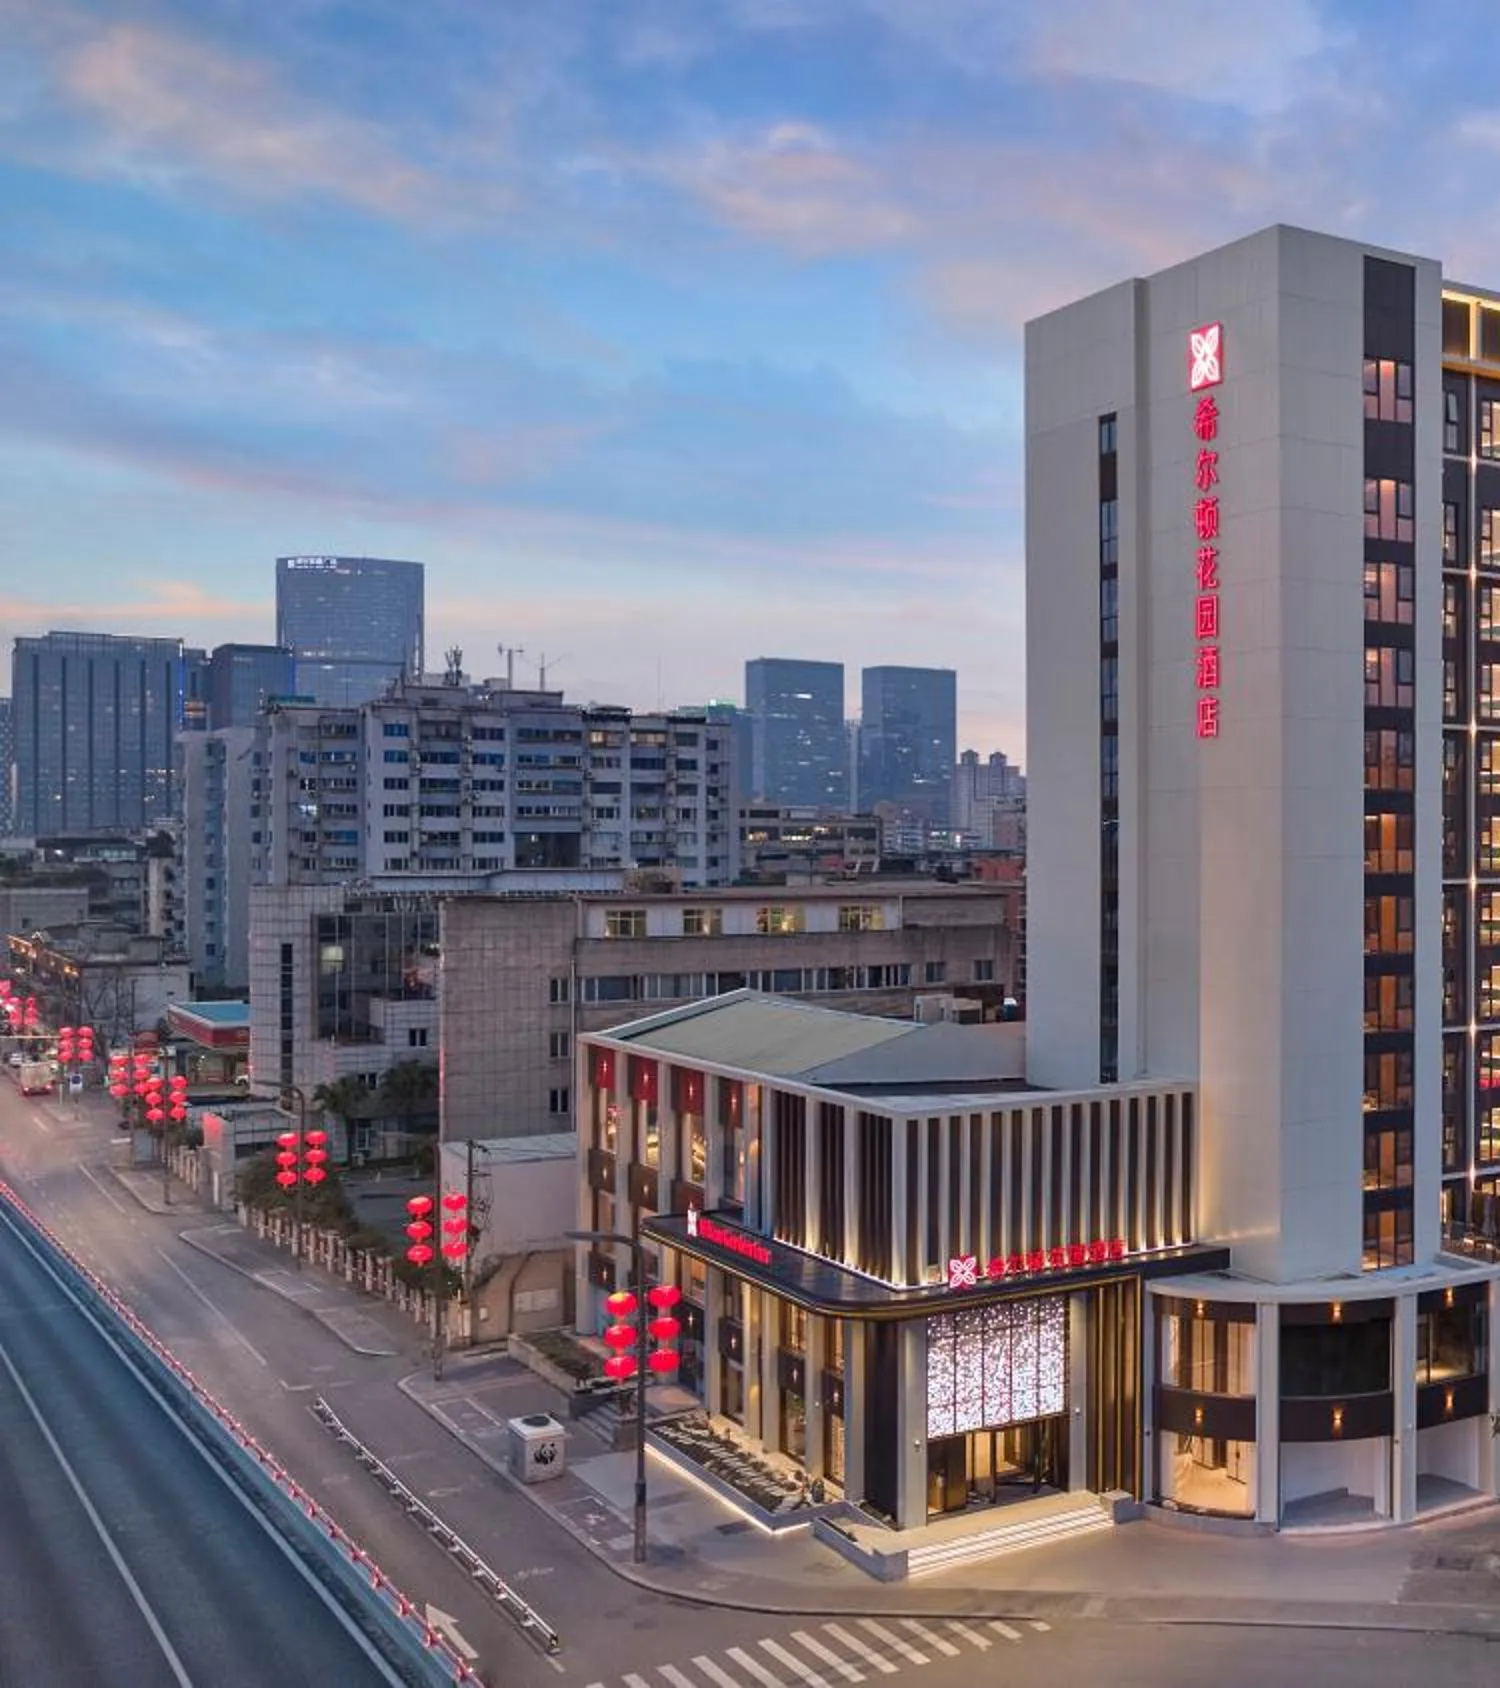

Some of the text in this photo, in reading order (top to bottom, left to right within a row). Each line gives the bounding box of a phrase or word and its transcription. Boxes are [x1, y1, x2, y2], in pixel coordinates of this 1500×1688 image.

[1193, 396, 1219, 738] 希尔顿花园酒店
